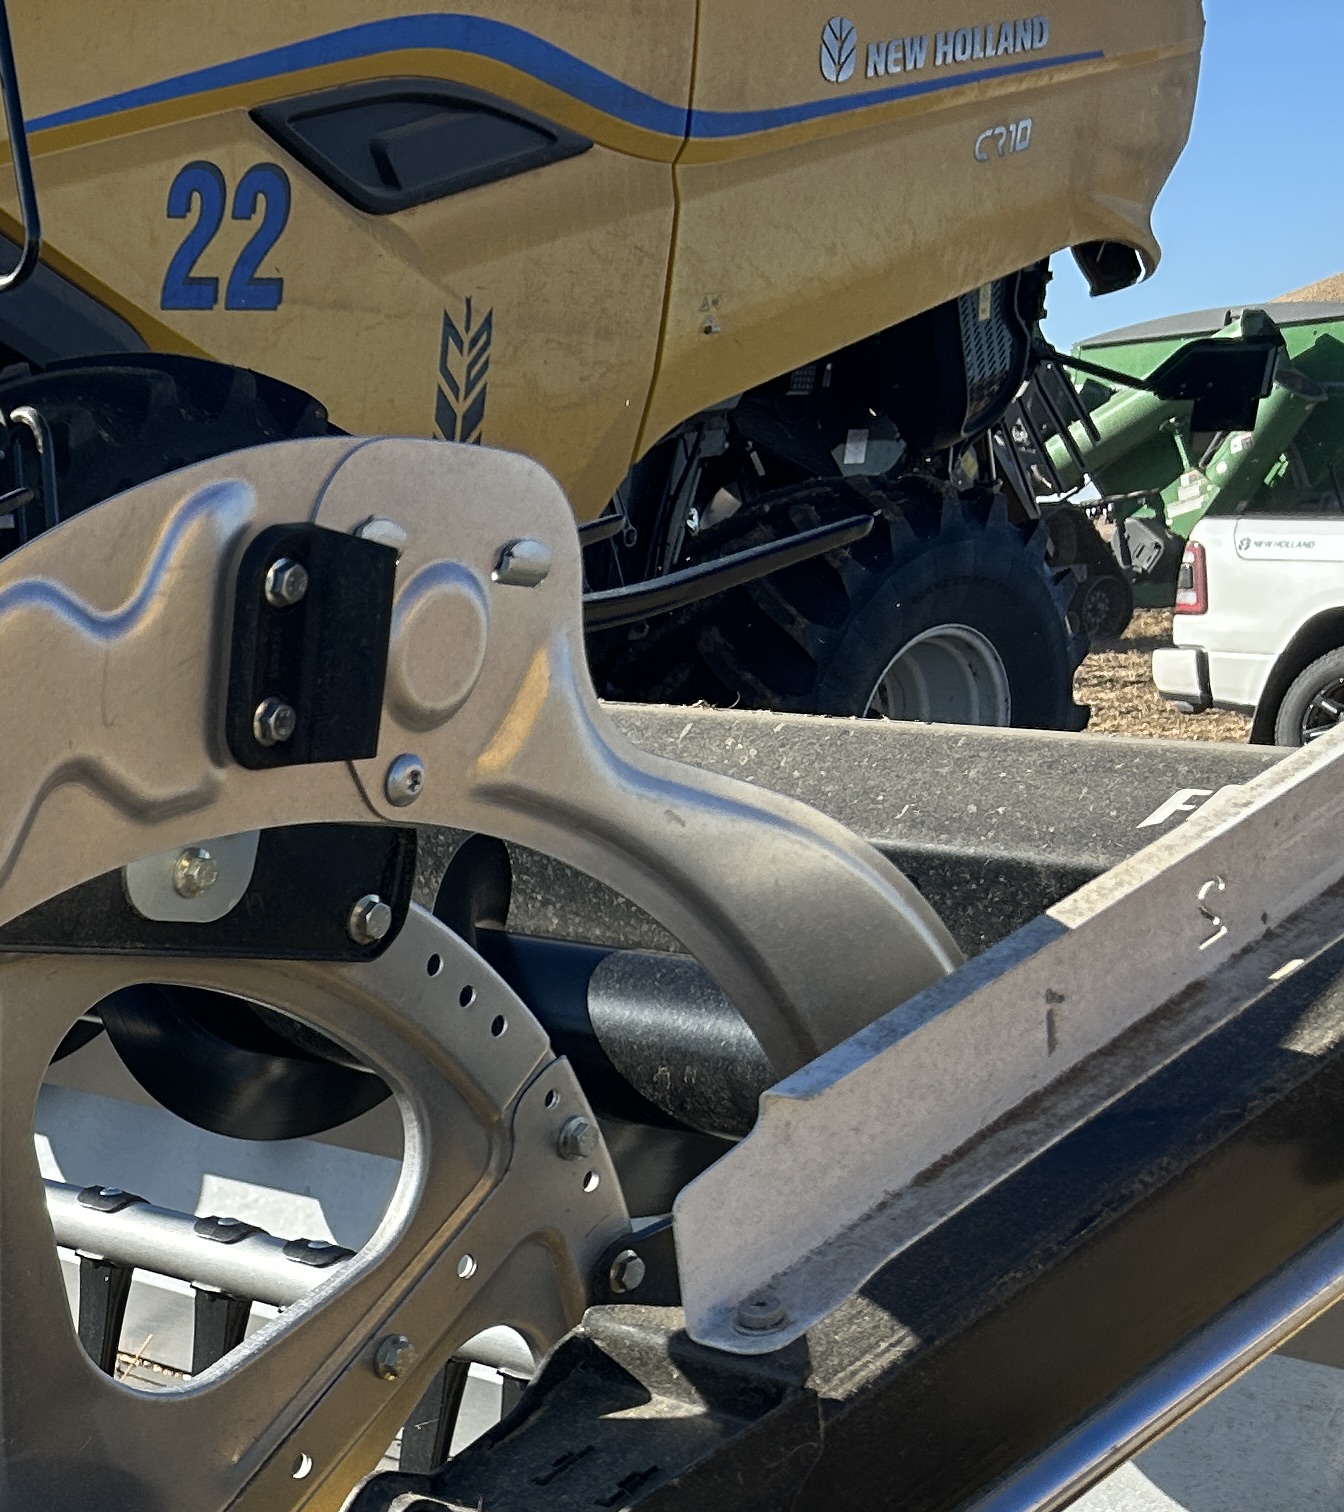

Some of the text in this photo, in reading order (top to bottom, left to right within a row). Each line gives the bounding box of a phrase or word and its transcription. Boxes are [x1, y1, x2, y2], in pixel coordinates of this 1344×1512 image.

[865, 15, 1050, 79] NEW HOLLAND
[974, 117, 1033, 163] CR10
[160, 160, 292, 311] 22
